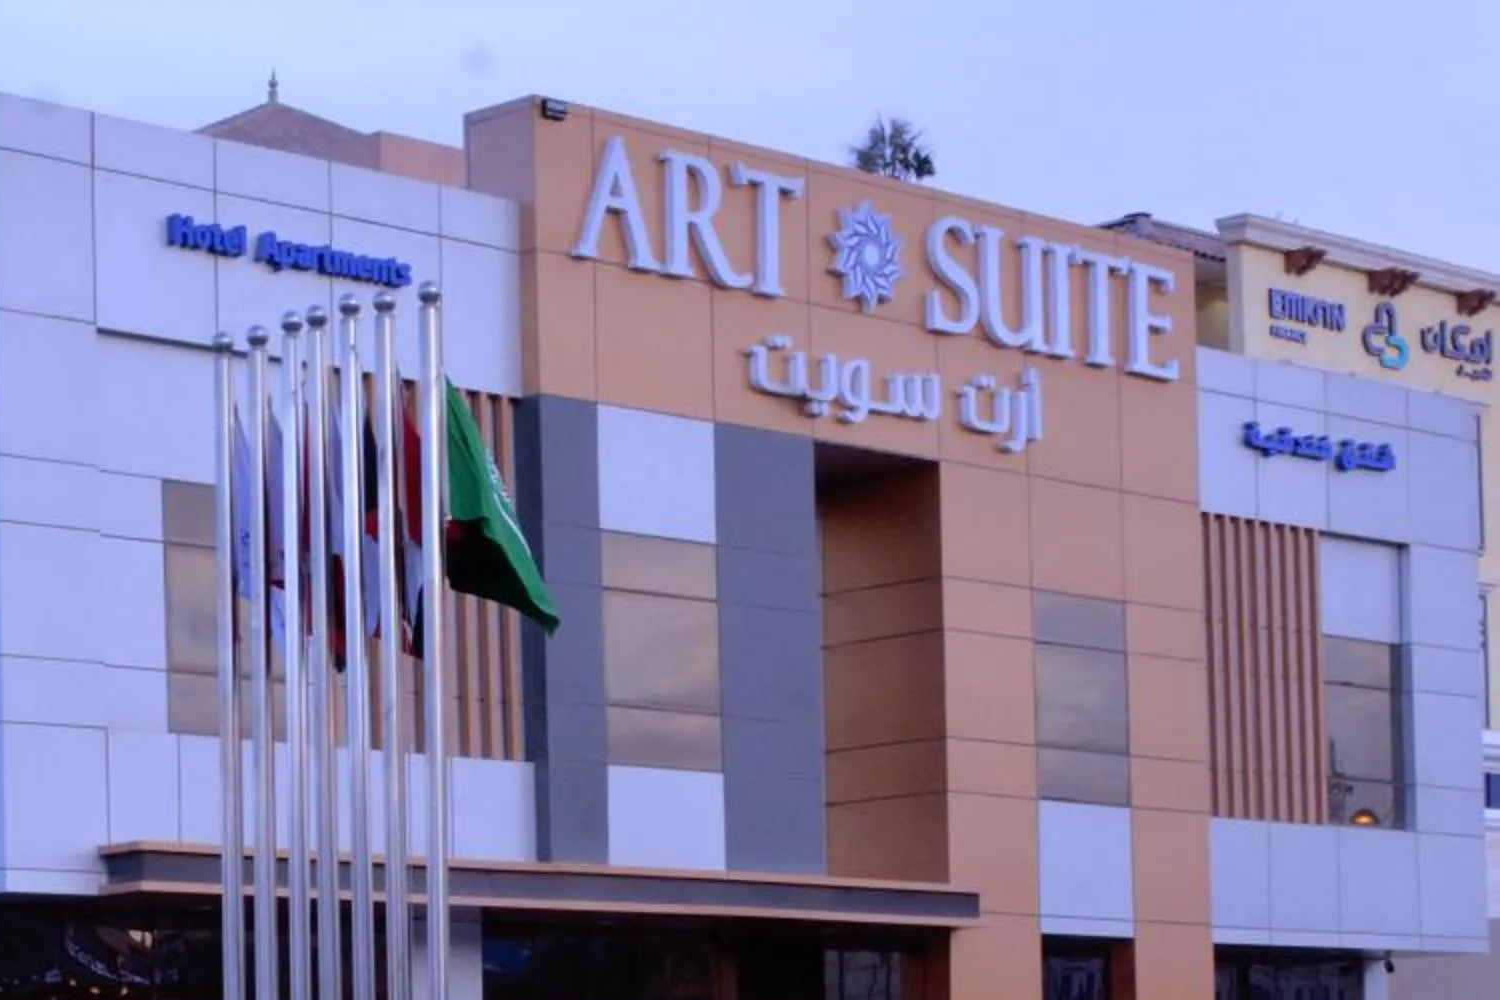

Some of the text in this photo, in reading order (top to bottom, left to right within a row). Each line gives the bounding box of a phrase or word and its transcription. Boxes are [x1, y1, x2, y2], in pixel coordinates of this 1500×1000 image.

[166, 214, 412, 288] Hotel Apartments
[571, 137, 1179, 382] ART SUITE
[745, 334, 1044, 453] أرت سويت
[1242, 420, 1396, 472] شقق فندقية
